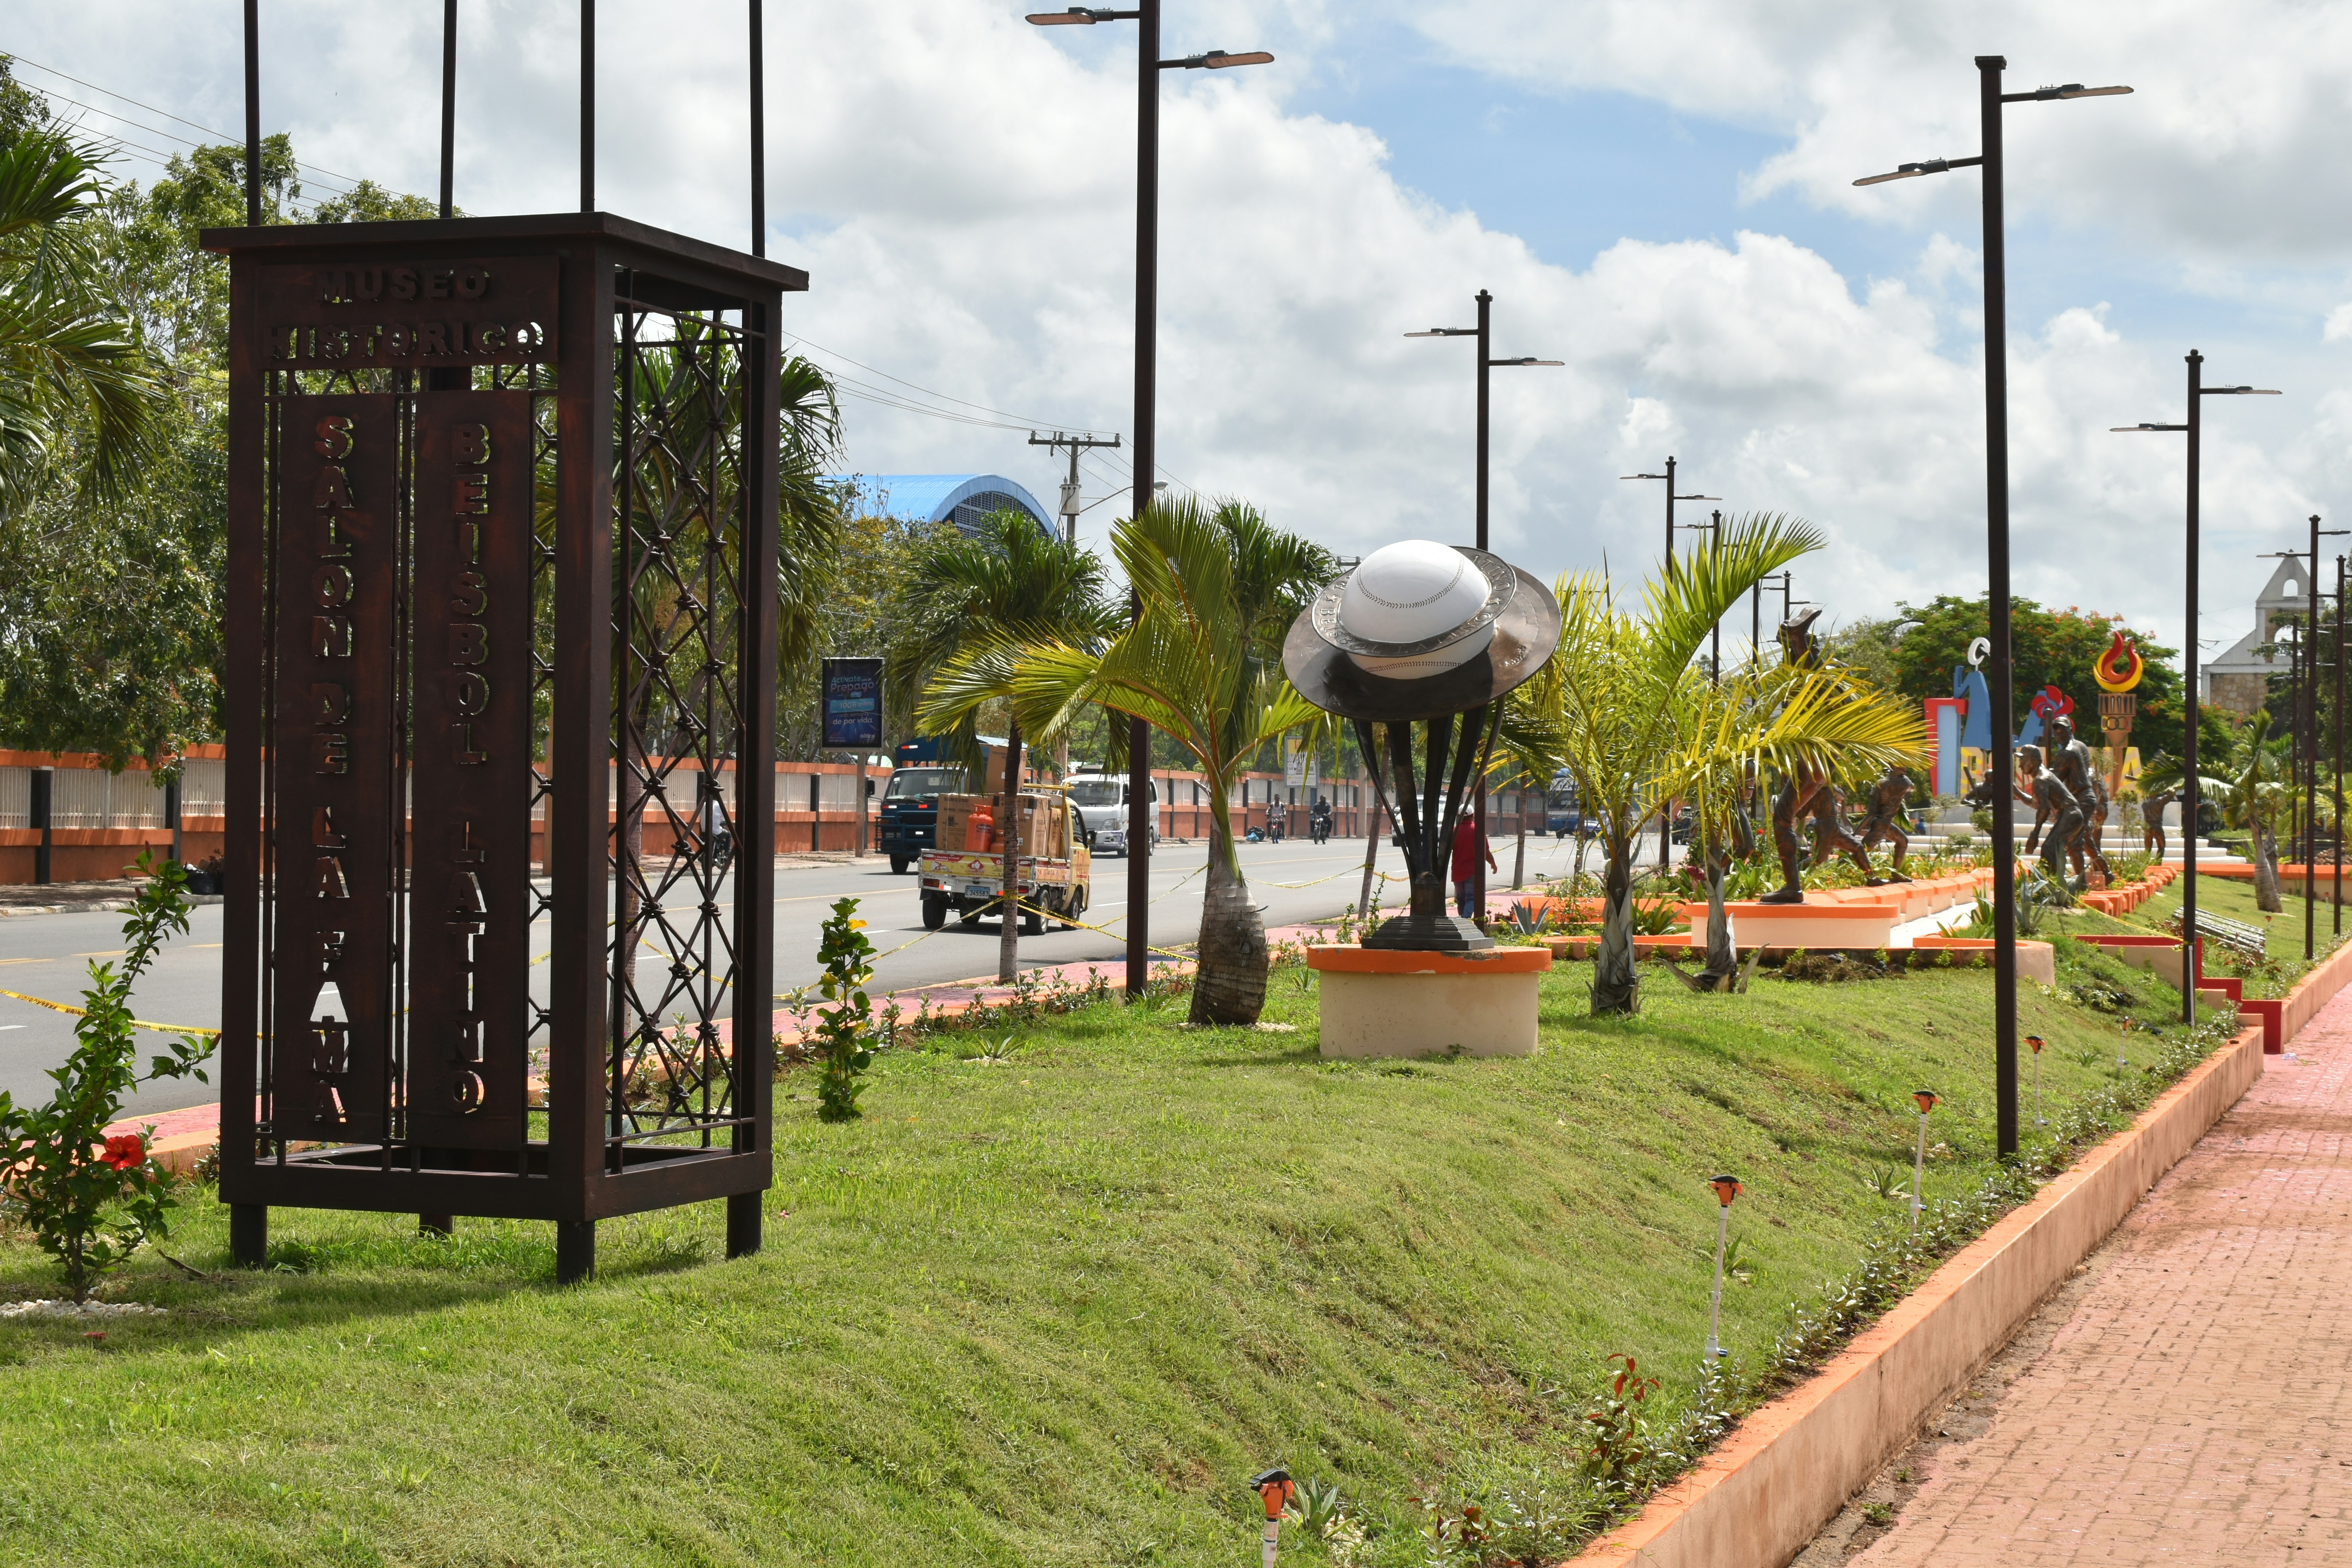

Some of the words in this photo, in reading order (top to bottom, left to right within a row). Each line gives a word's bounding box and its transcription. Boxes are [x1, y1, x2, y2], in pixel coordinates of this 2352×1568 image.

[316, 267, 489, 303] MUSEO
[263, 321, 541, 358] HISTORICO
[311, 416, 353, 656] SALON
[446, 423, 490, 764] BEISBOL
[1320, 608, 1382, 653] BEISBOL
[1394, 613, 1493, 653] LATINO
[311, 682, 350, 773] DE
[831, 682, 874, 693] Prepago
[306, 807, 349, 898] LA
[445, 822, 486, 1114] LATINO
[303, 931, 348, 1122] FAMA
